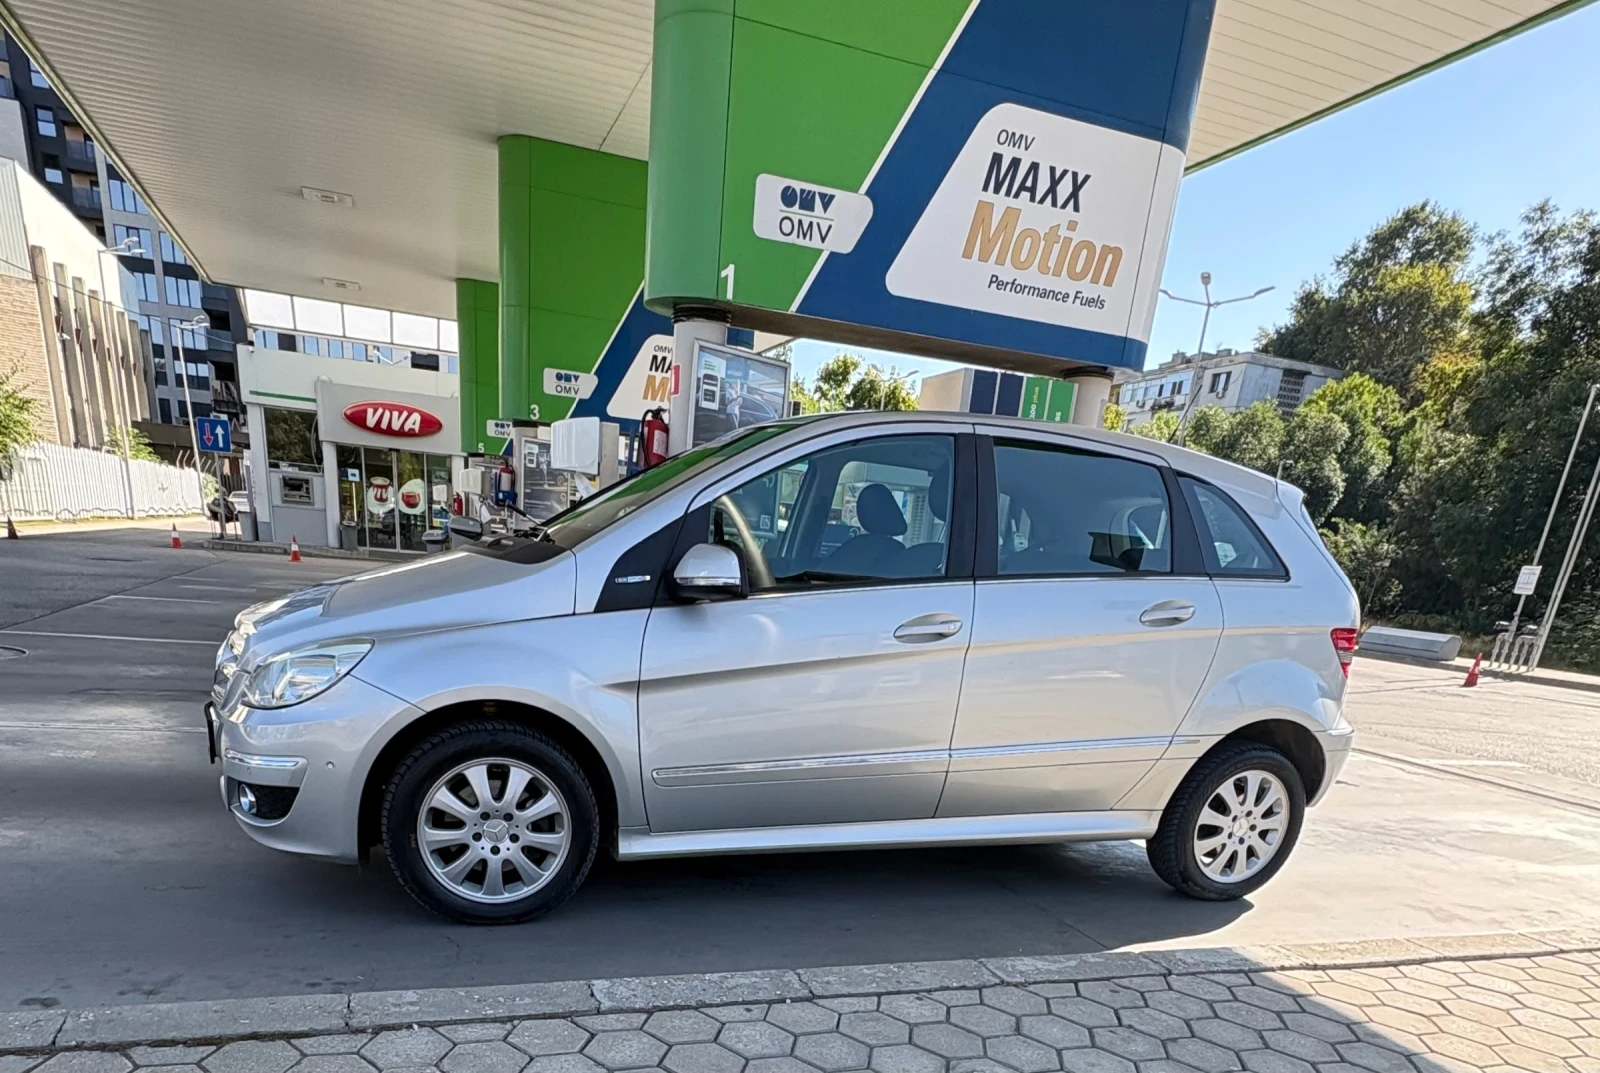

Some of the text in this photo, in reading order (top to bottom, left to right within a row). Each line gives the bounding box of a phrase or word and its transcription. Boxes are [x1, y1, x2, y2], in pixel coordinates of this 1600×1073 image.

[996, 128, 1036, 151] OMV
[981, 151, 1092, 213] MAXX
[779, 216, 833, 244] OMV
[961, 199, 1123, 287] Motion
[720, 263, 735, 300] 1
[987, 274, 1106, 310] Performance Fuels
[555, 384, 580, 395] OMV
[366, 407, 421, 433] VIVA
[529, 404, 540, 420] 3
[477, 442, 485, 453] 5
